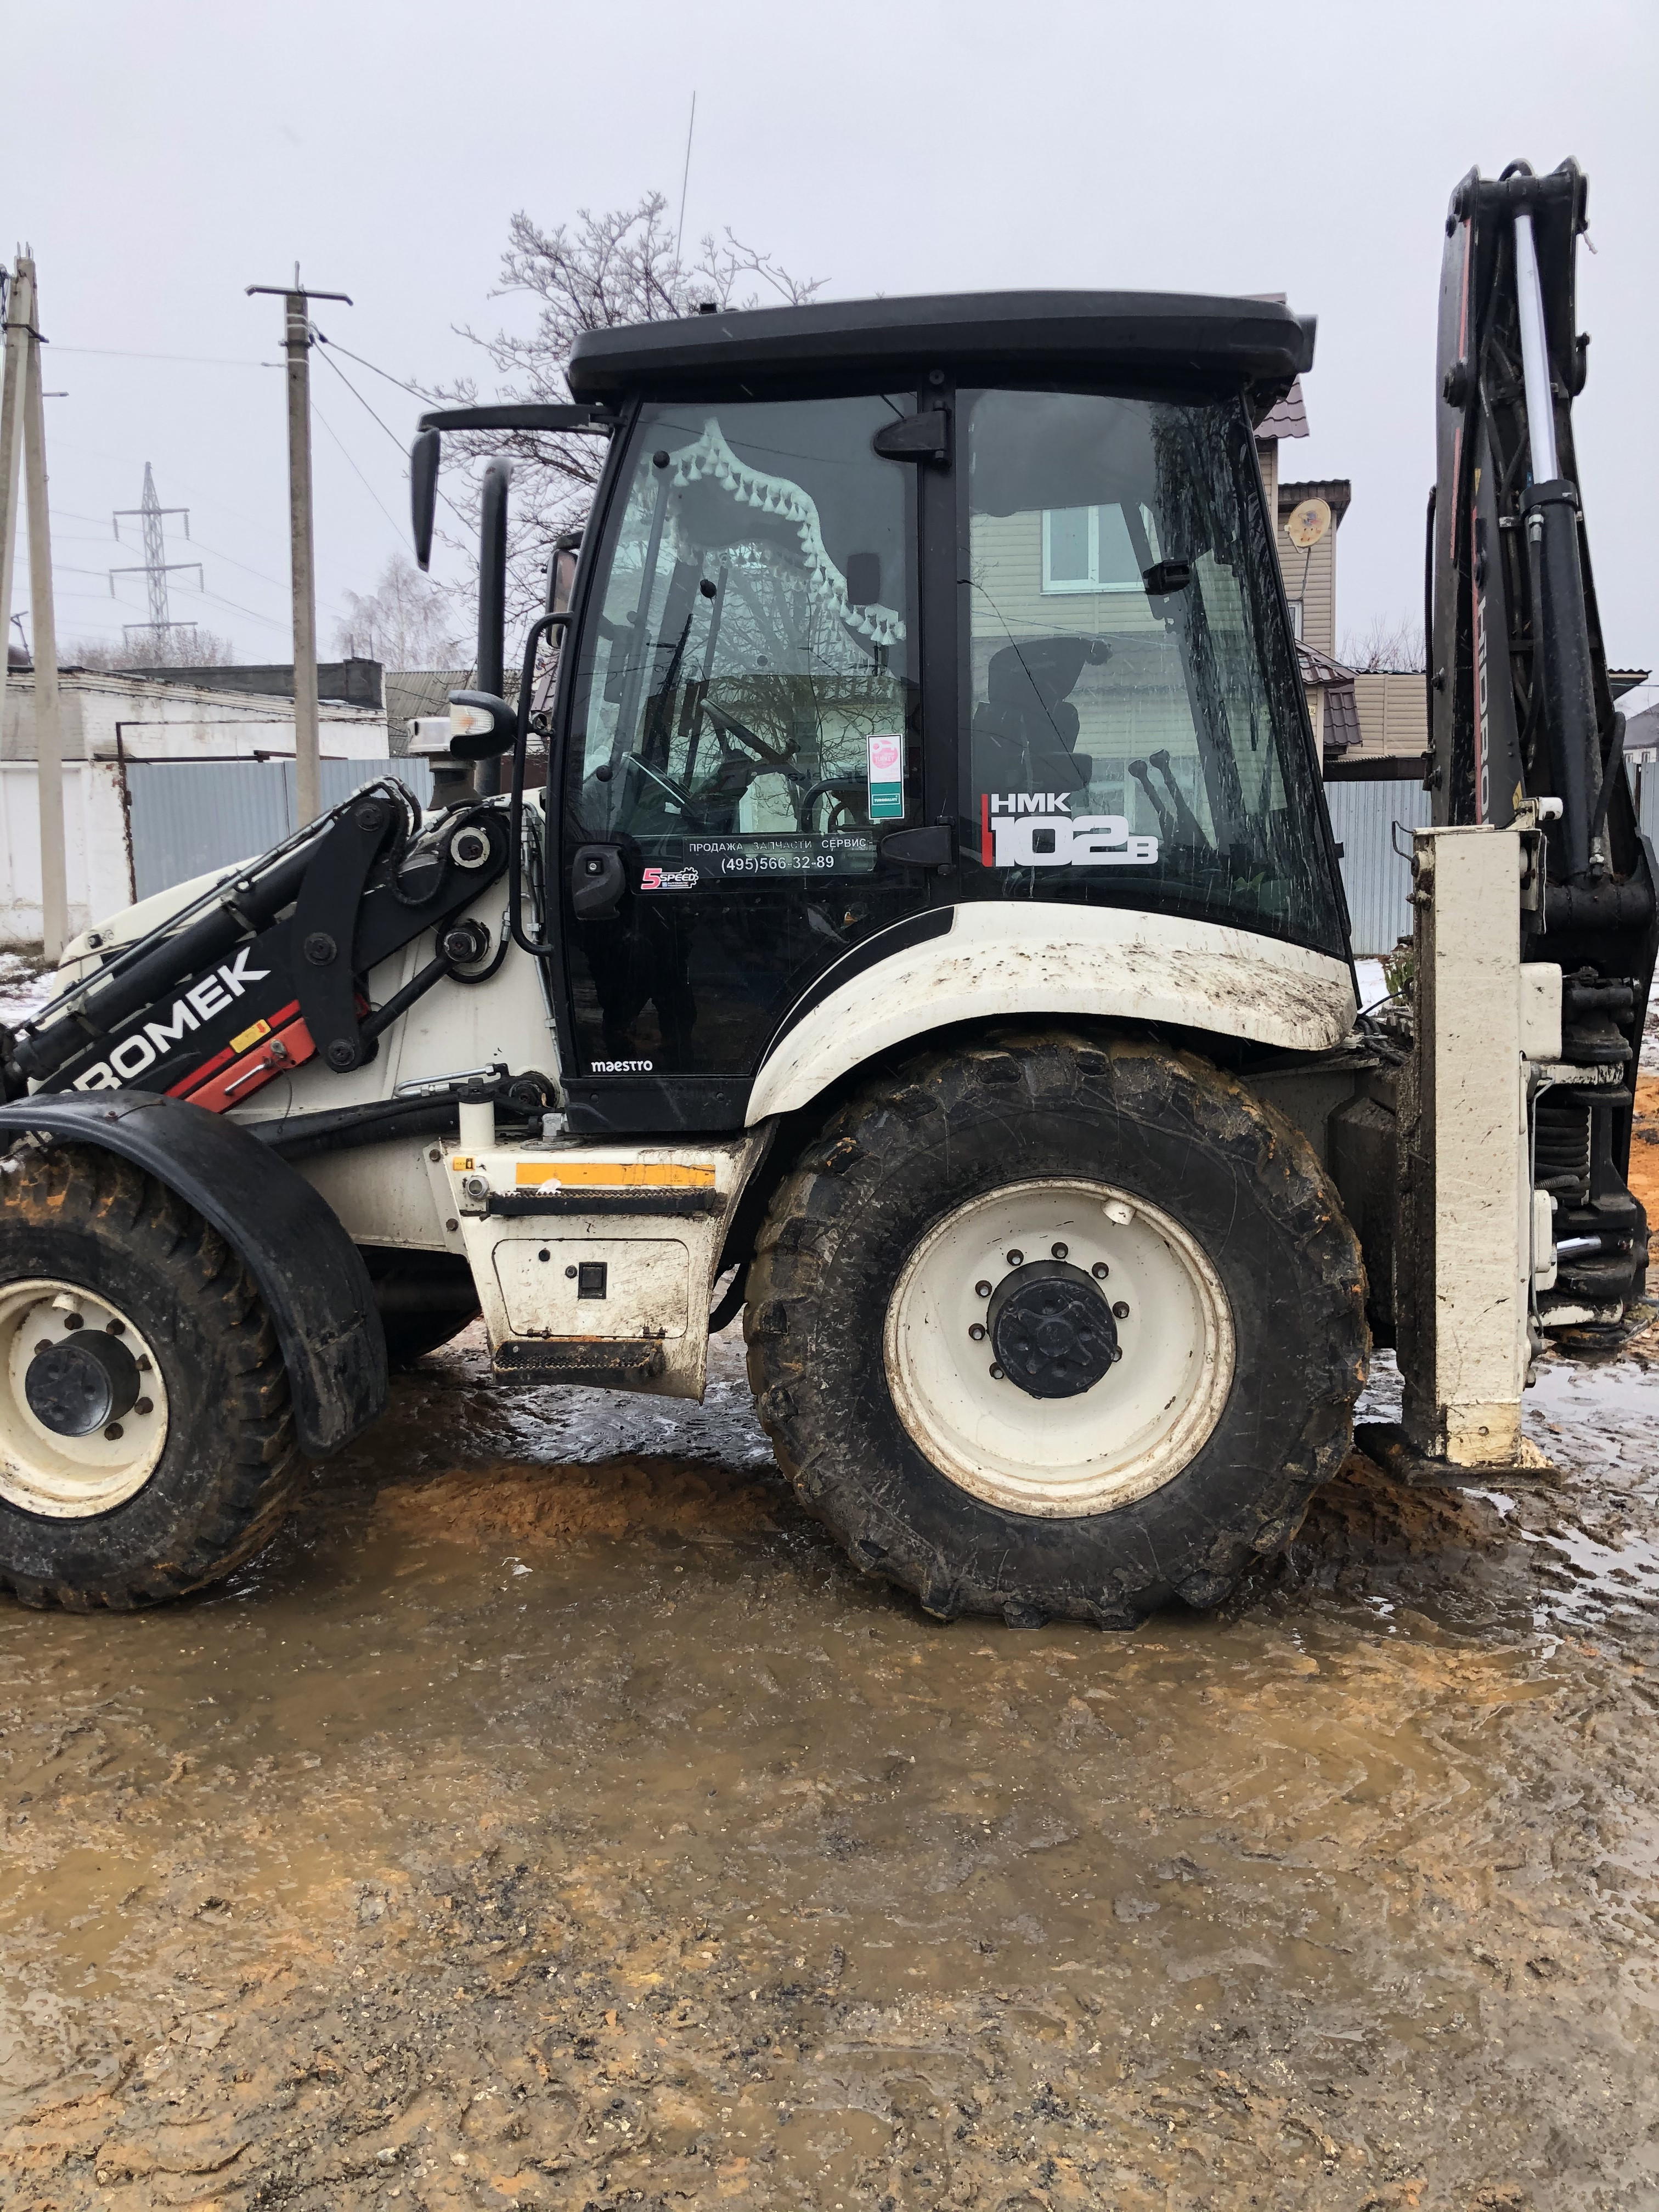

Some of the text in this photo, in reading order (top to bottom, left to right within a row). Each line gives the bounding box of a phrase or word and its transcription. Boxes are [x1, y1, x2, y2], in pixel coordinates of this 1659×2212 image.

[1478, 596, 1489, 824] HIDRO
[991, 793, 1071, 812] HMK
[689, 838, 866, 853] ПРОДАЖА ЗАПЧАСТИ СЕРВИС
[992, 815, 1159, 867] 102B
[721, 855, 834, 873] (495)566-32-89
[591, 1060, 653, 1072] maestro
